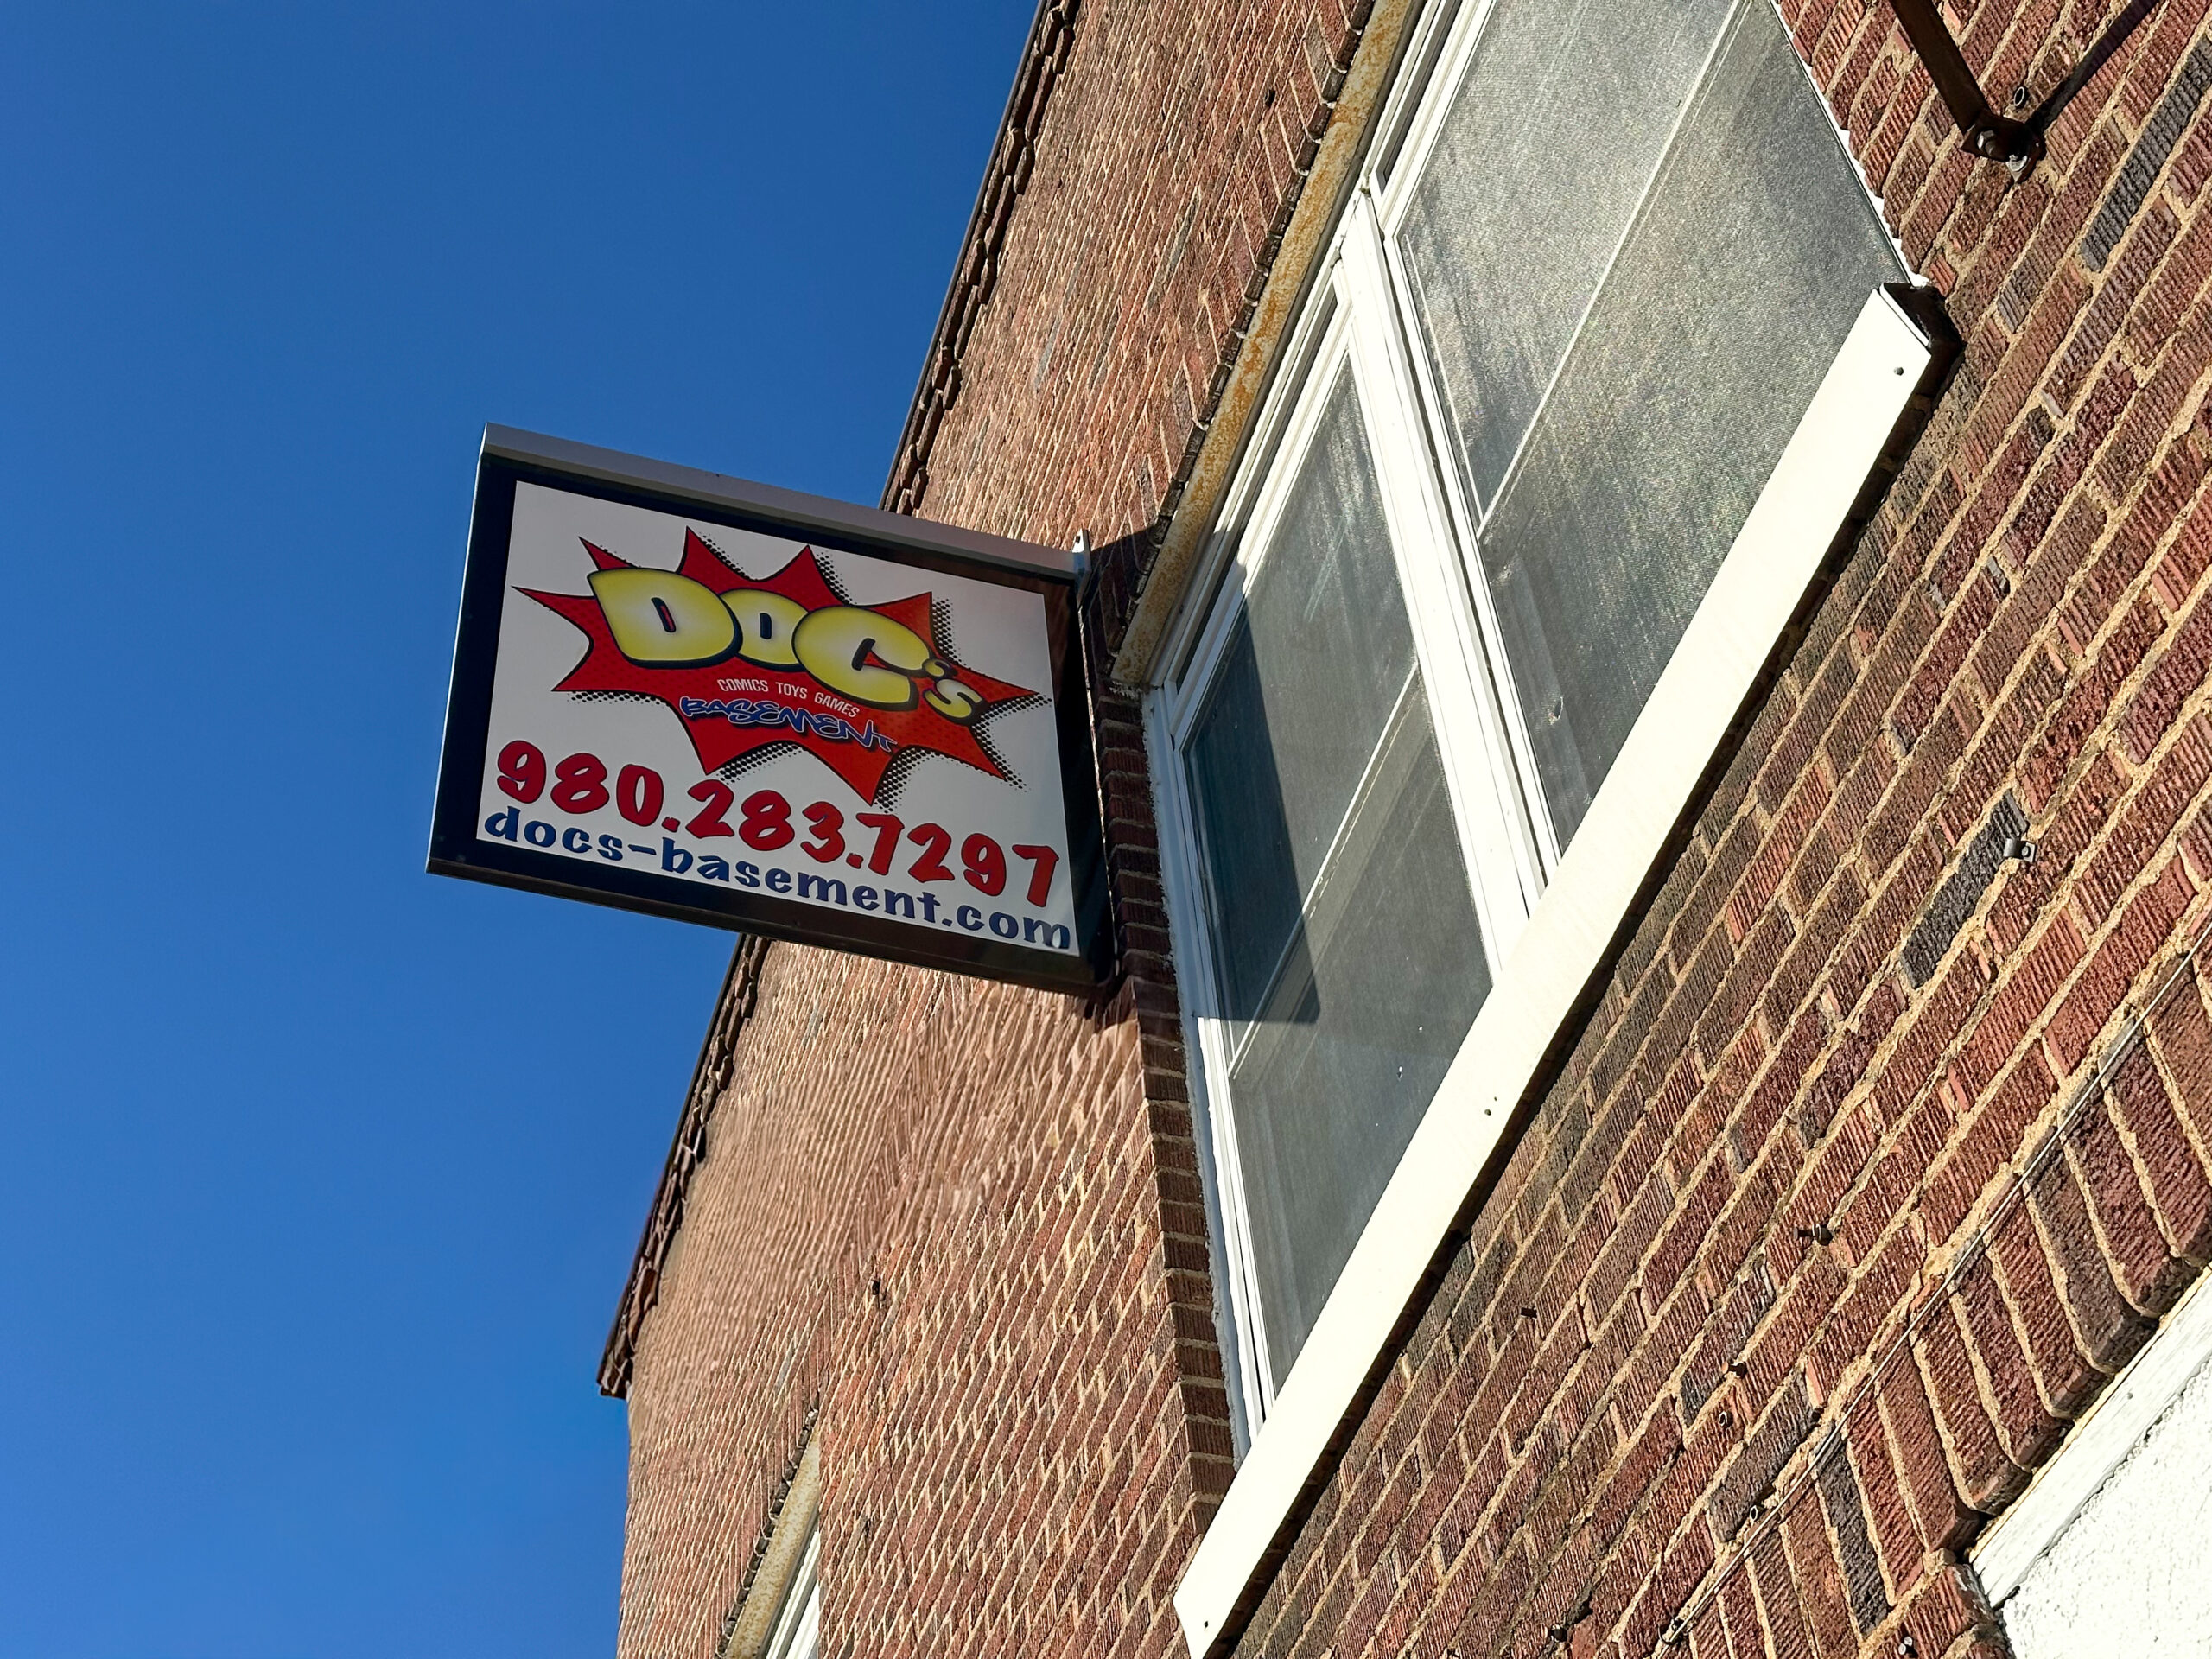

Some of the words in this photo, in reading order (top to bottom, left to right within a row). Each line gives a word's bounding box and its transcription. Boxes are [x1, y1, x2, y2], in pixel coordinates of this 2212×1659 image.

[716, 678, 769, 692] COMICS
[775, 681, 808, 699] TOYS
[814, 691, 860, 718] GAMES
[484, 805, 1071, 950] docs-basement.com
[497, 740, 1059, 907] 980.283.7297
